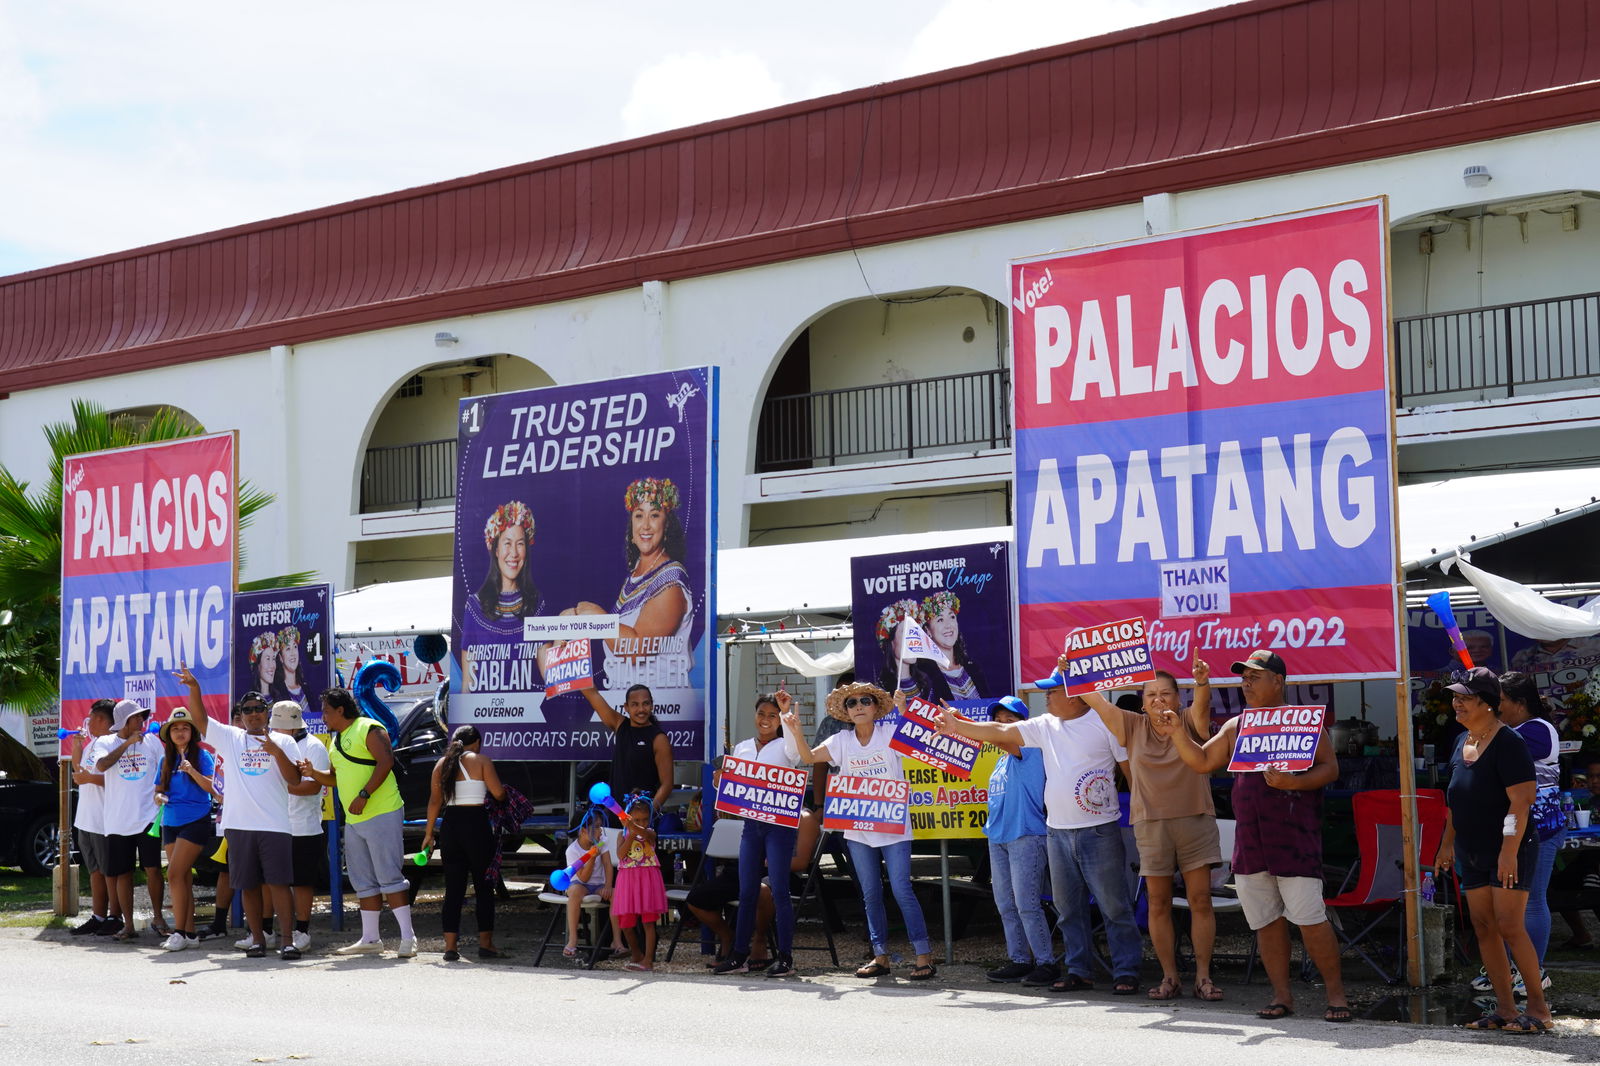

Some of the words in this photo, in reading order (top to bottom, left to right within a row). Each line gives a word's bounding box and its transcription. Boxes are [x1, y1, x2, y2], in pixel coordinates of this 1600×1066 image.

[1034, 258, 1371, 405] PALACIOS
[461, 402, 480, 432] #1
[511, 392, 648, 440] TRUSTED
[482, 426, 676, 479] LEADERSHIP
[1026, 426, 1377, 568] APATANG
[73, 470, 228, 560] PALACIOS
[888, 563, 911, 575] THIS
[912, 557, 966, 571] NOVEMBER
[1163, 565, 1227, 587] THANK
[863, 575, 907, 595] VOTE
[910, 571, 944, 590] FOR
[946, 567, 993, 594] Change
[258, 603, 272, 612] THIS
[272, 600, 304, 611] NOVEMBER
[1174, 593, 1218, 613] YOU!
[242, 612, 269, 628] VOTE
[270, 610, 291, 625] FOR
[527, 624, 546, 632] Thank
[547, 625, 558, 633] you
[559, 623, 568, 631] for
[569, 622, 587, 631] YOUR
[588, 621, 615, 632] Support!
[65, 585, 225, 675] APATANG
[1064, 620, 1144, 653] PALACIOS
[1197, 618, 1262, 650] Trust
[1268, 616, 1346, 649] 2022
[306, 632, 323, 661] #1
[467, 643, 511, 661] CHRISTINA
[614, 637, 640, 656] LEILA
[641, 635, 684, 655] FLEMING
[1107, 638, 1145, 650] GOVERNOR
[546, 659, 590, 686] APATANG
[1069, 647, 1147, 677] APATANG
[1103, 670, 1113, 678] LT.
[1114, 664, 1152, 676] GOVERNOR
[126, 679, 155, 692] THANK
[468, 659, 532, 692] SABLAN
[1094, 675, 1134, 690] 2022
[474, 706, 524, 718] GOVERNOR
[491, 697, 505, 707] FOR
[1243, 708, 1323, 728] PALACIOS
[483, 731, 568, 748] DEMOCRATS
[570, 731, 600, 748] FOR
[1239, 735, 1314, 754] APATANG
[910, 749, 949, 771] 2022
[924, 746, 935, 754] LT.
[934, 751, 972, 770] GOVERNOR
[1275, 752, 1312, 760] GOVERNOR
[725, 758, 806, 788] PALACIOS
[723, 782, 799, 810] APATANG
[767, 782, 803, 794] GOVERNOR
[828, 775, 907, 799] PALACIOS
[936, 785, 989, 809] Apata
[739, 808, 777, 823] 2022
[762, 805, 798, 817] GOVERNOR
[826, 797, 905, 820] APATANG
[853, 821, 874, 831] 2022
[910, 811, 965, 830] RUN-OFF
